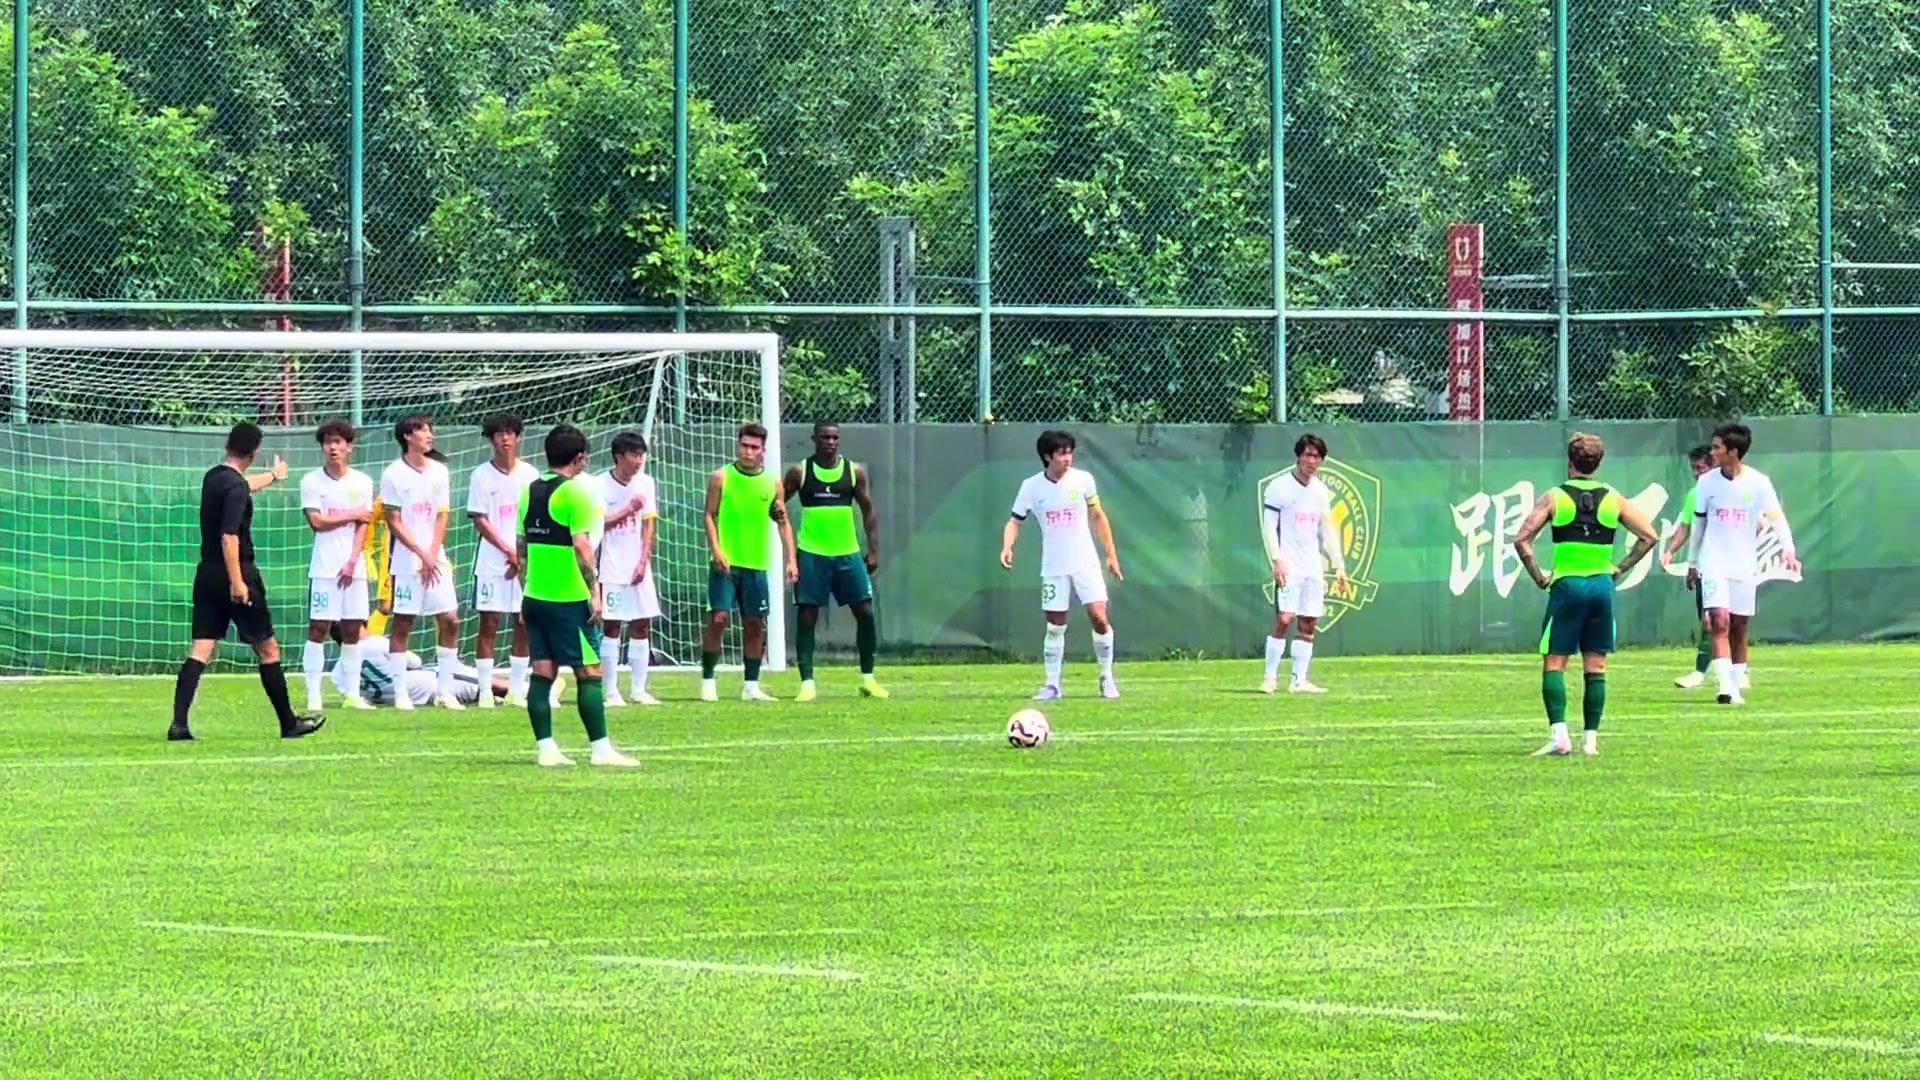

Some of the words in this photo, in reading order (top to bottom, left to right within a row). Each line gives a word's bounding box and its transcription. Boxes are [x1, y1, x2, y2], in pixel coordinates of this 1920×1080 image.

[1350, 525, 1365, 560] CLUB
[312, 591, 329, 608] 98
[606, 591, 623, 608] 69
